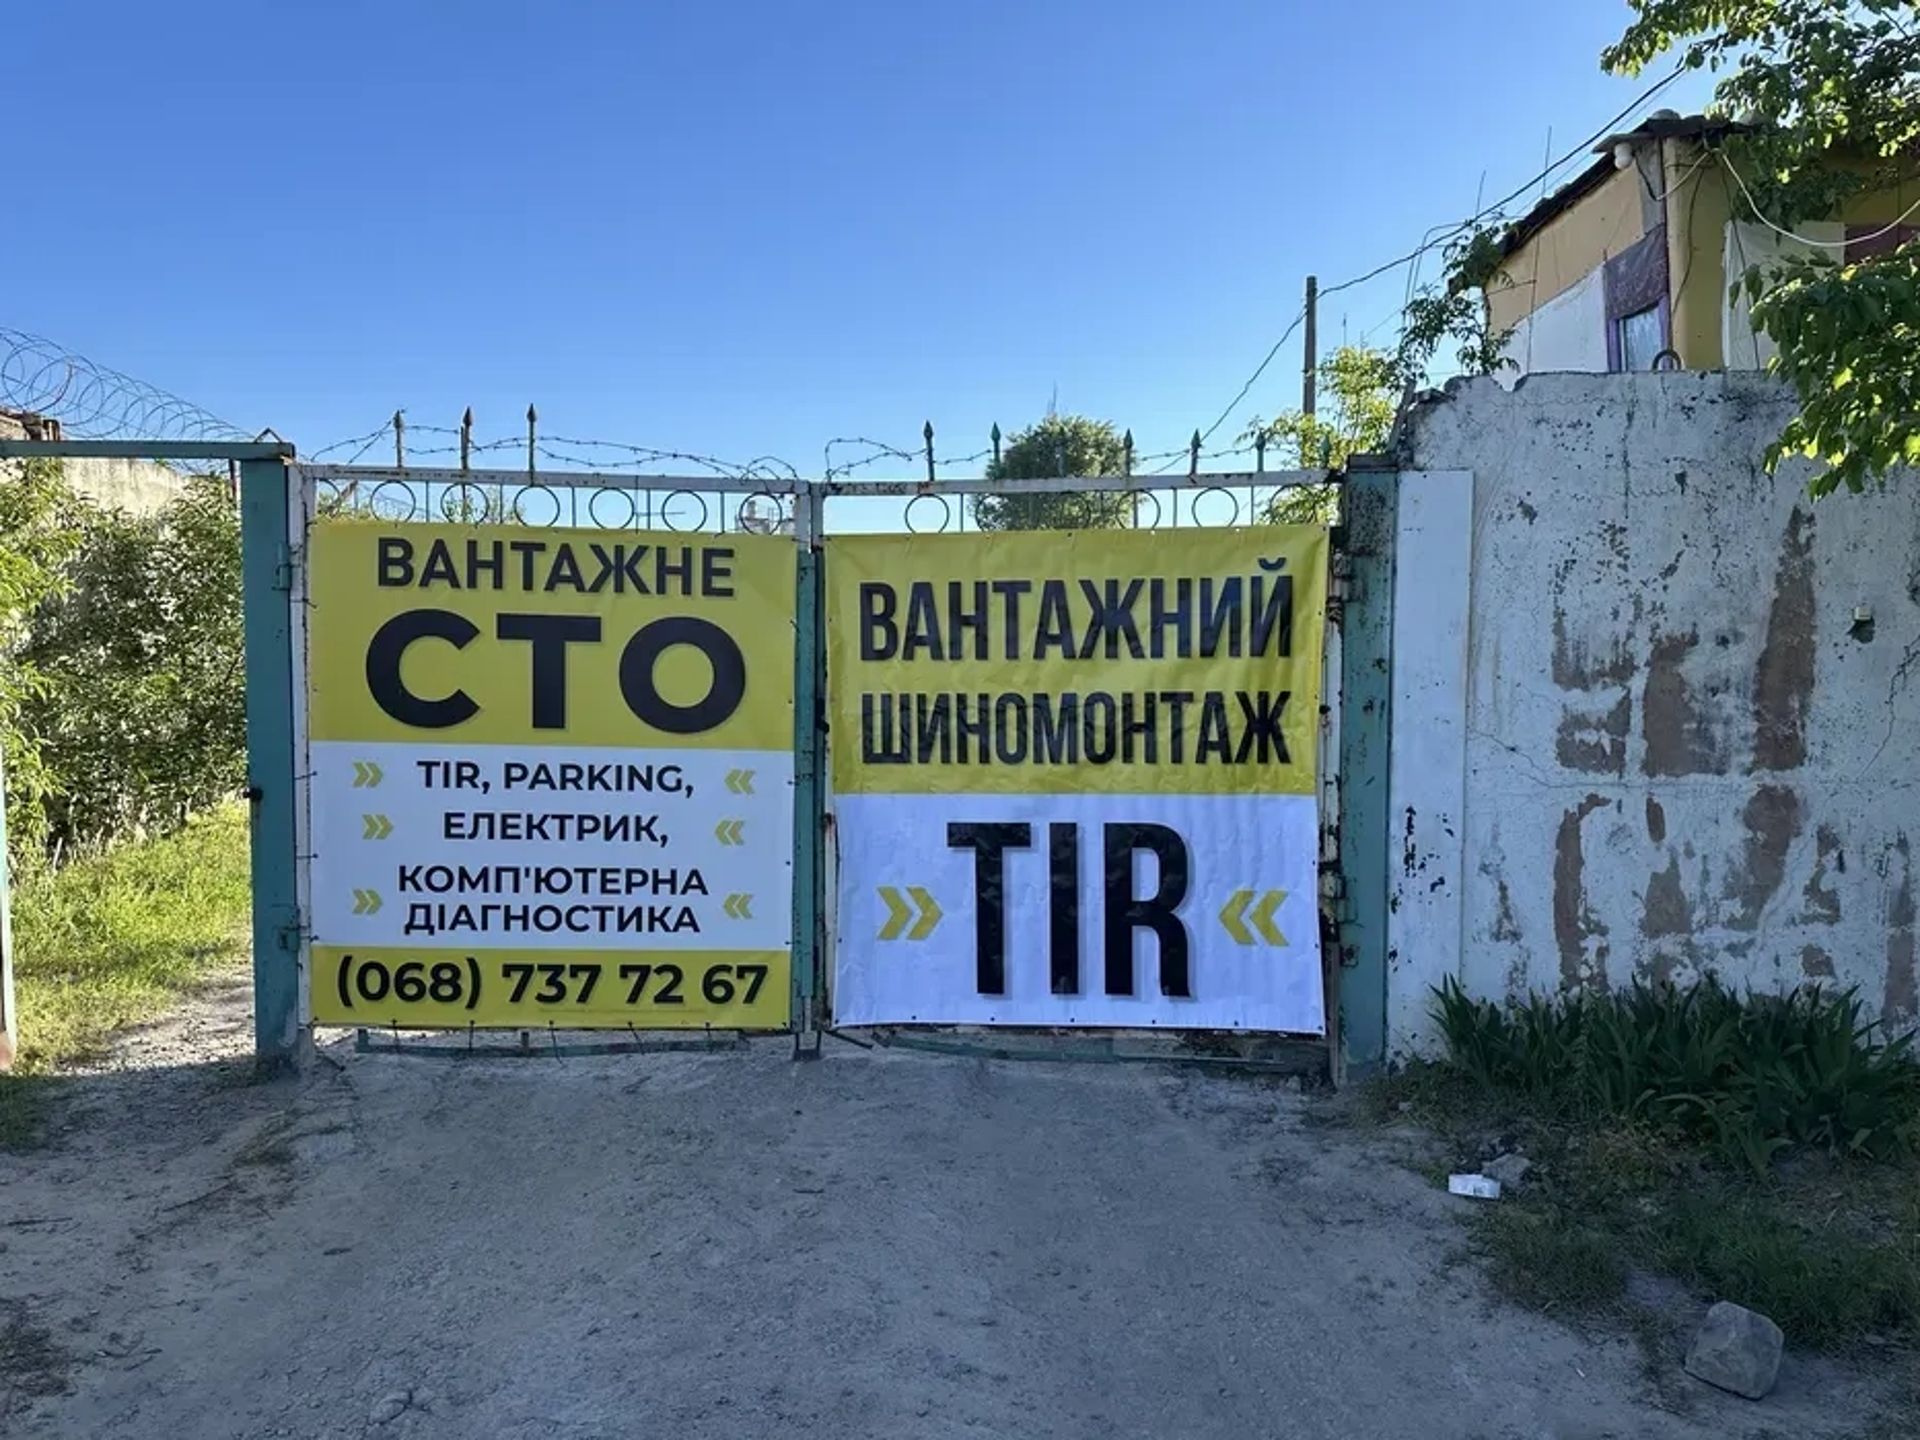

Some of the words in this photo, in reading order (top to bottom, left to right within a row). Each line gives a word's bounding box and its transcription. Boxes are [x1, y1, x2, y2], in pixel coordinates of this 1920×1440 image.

[377, 537, 735, 597] ВАНТАЖНЕ
[859, 557, 1294, 661] ВАНТАЖНИЙ
[366, 608, 747, 734] СТО
[861, 690, 1292, 764] ШИНОМОНТАЖ
[416, 761, 491, 795] TIR,
[503, 763, 694, 798] PARKING,
[443, 812, 668, 848] ЕЛЕКТРИК,
[399, 865, 709, 896] КОМП'ЮТЕРНА
[404, 904, 701, 935] ДІАГНОСТИКА
[947, 822, 1191, 997] TIR
[337, 956, 482, 1009] (068)
[502, 964, 601, 1003] 737
[619, 964, 684, 1004] 72
[701, 964, 768, 1004] 67
